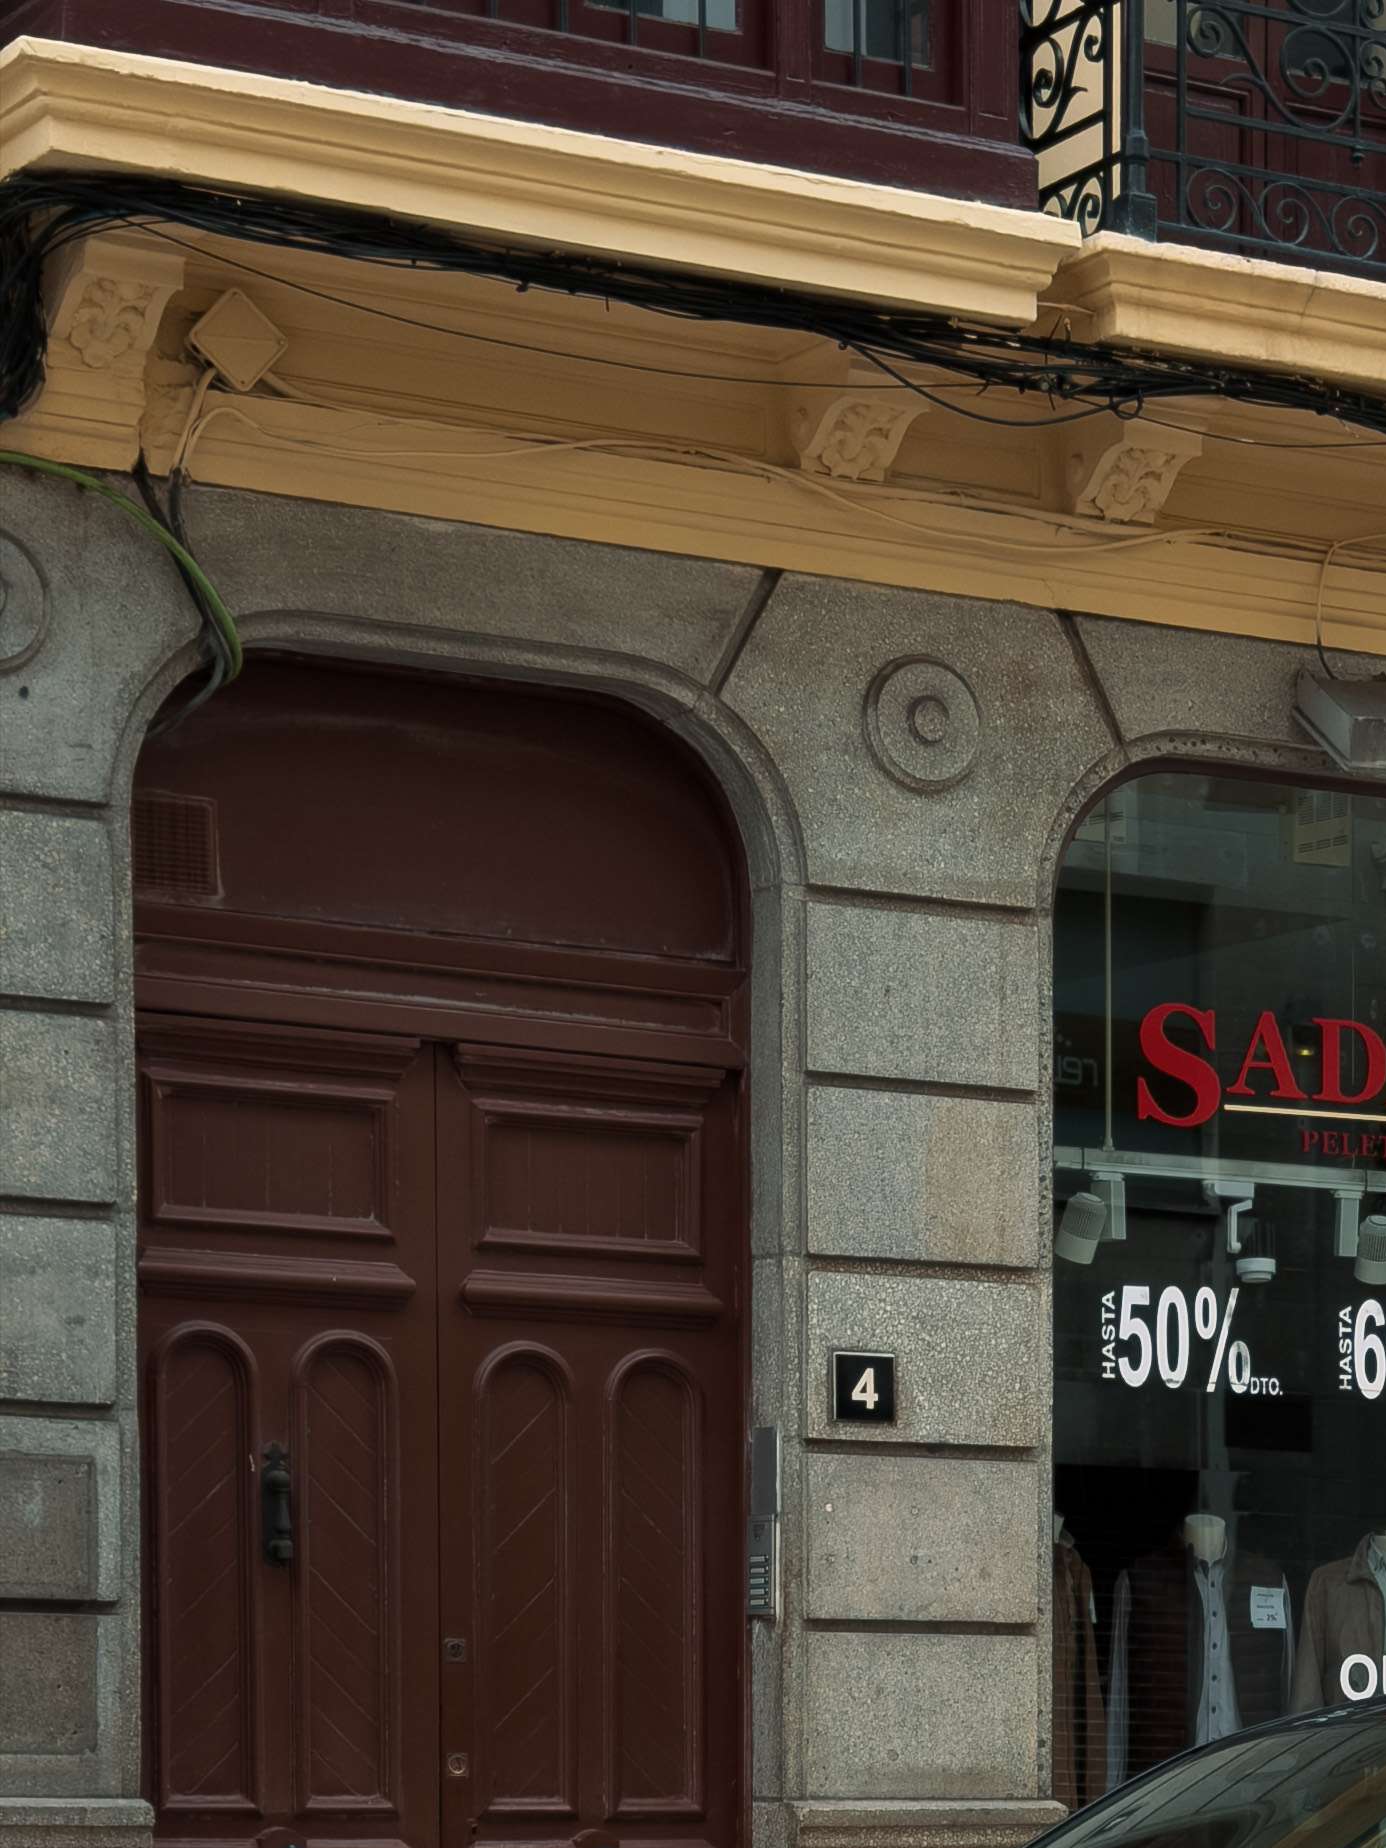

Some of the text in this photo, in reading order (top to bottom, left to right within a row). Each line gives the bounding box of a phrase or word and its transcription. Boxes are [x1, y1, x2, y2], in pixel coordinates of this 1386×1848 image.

[1102, 1285, 1283, 1396] HASTA 50% DTO.
[1339, 1306, 1352, 1390] HASTA
[852, 1368, 878, 1409] 4
